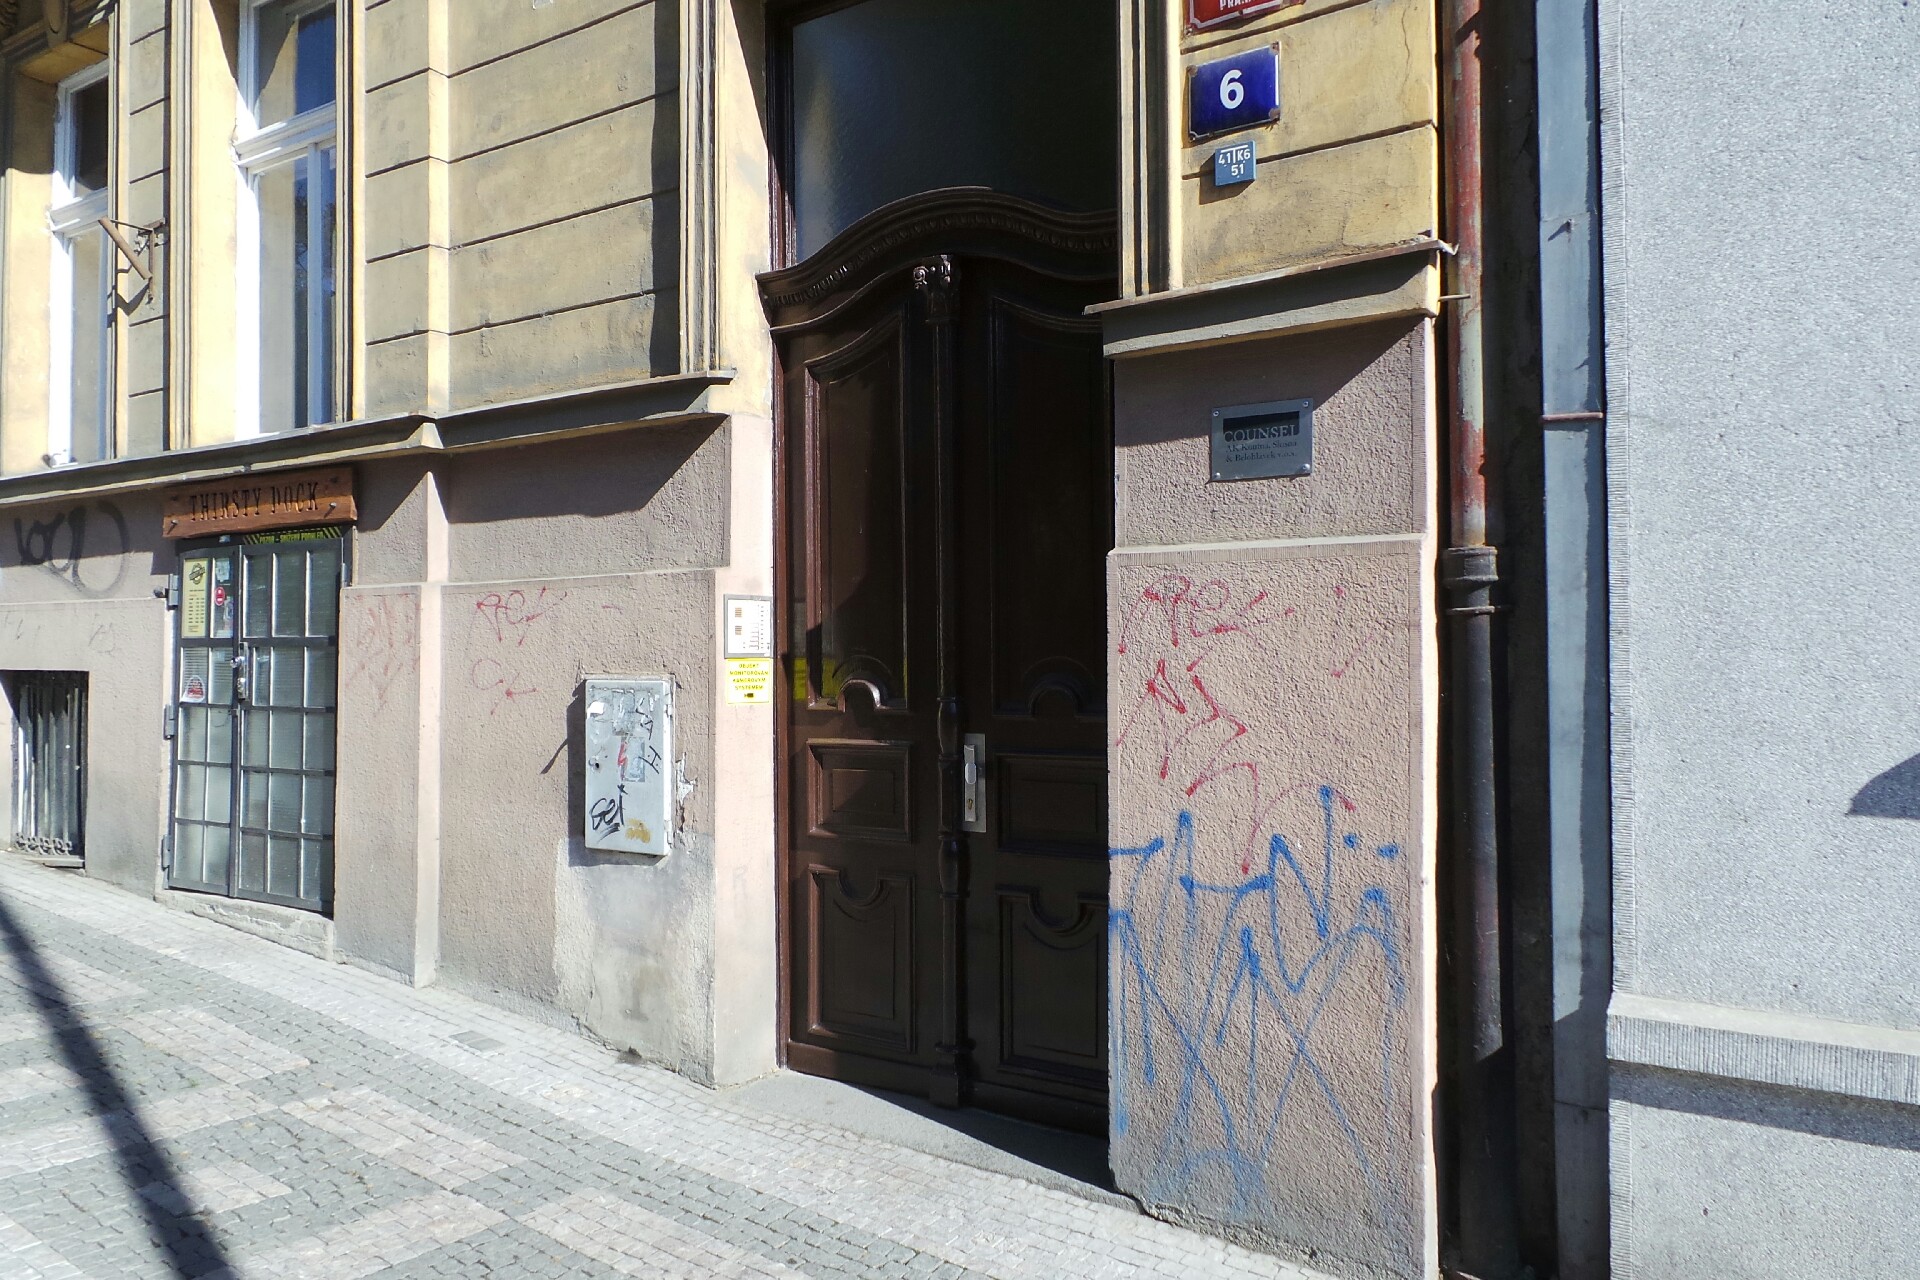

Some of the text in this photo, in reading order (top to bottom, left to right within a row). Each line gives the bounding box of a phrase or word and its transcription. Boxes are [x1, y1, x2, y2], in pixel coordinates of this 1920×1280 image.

[1220, 69, 1244, 109] 6
[1223, 424, 1296, 443] COUNSEL
[190, 487, 262, 521] THIRSTY
